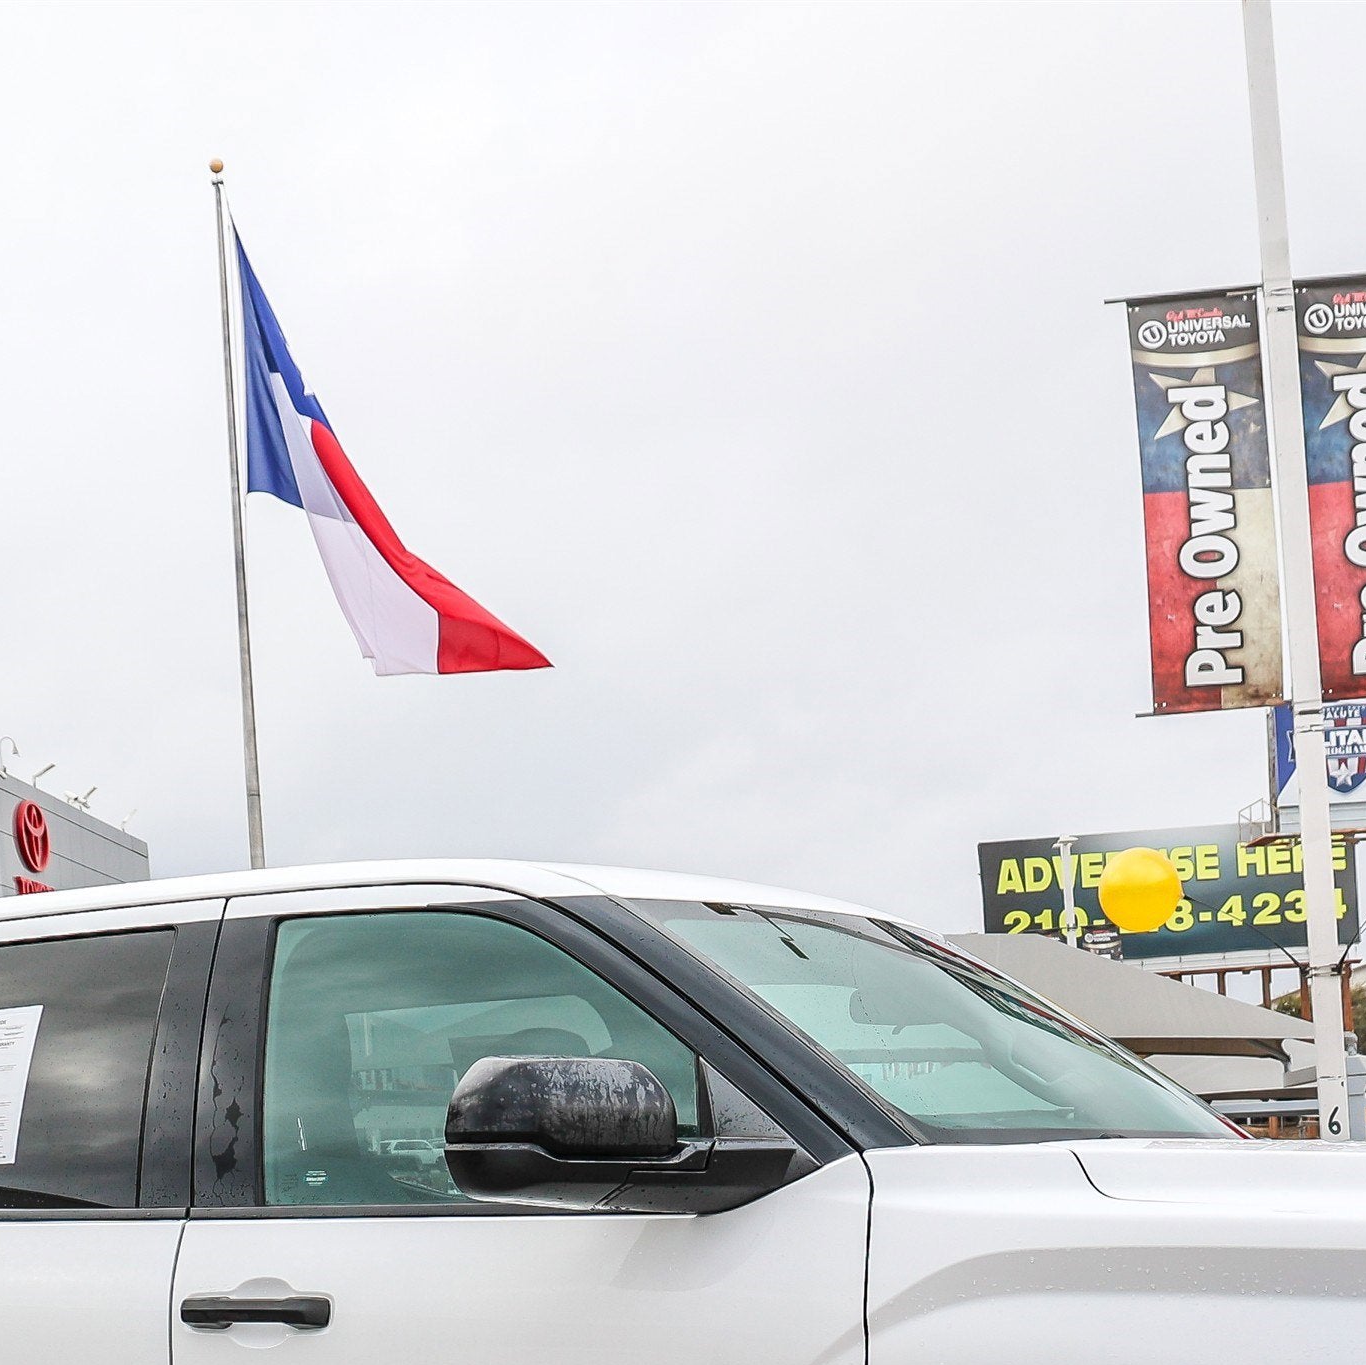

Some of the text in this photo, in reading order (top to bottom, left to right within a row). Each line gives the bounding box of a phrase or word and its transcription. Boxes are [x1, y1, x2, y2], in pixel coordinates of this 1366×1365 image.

[1167, 313, 1251, 334] UNIVERSAL
[1168, 329, 1226, 348] TOYOTA
[1167, 385, 1243, 687] Pre Owned
[1328, 1105, 1342, 1135] 6
